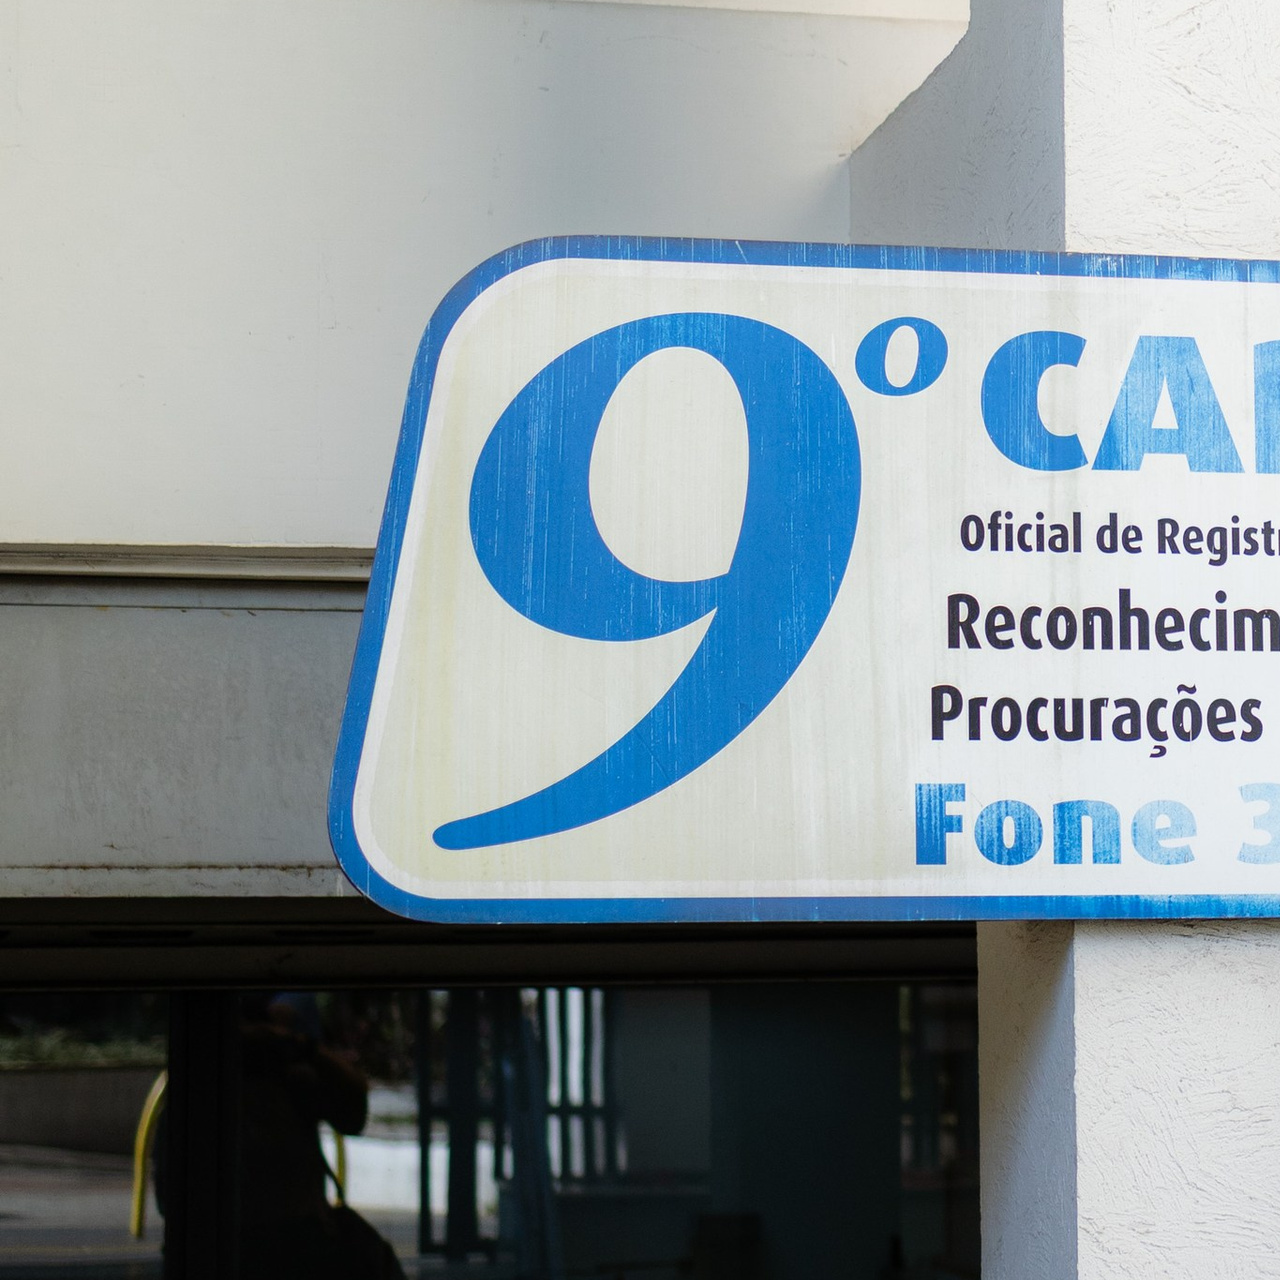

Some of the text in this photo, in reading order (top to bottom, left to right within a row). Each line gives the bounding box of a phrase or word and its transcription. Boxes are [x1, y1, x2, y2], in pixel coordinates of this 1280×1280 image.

[960, 510, 1082, 553] Oficial
[1096, 512, 1143, 554] de
[931, 684, 1263, 758] Procurações
[914, 782, 1197, 867] Fone
